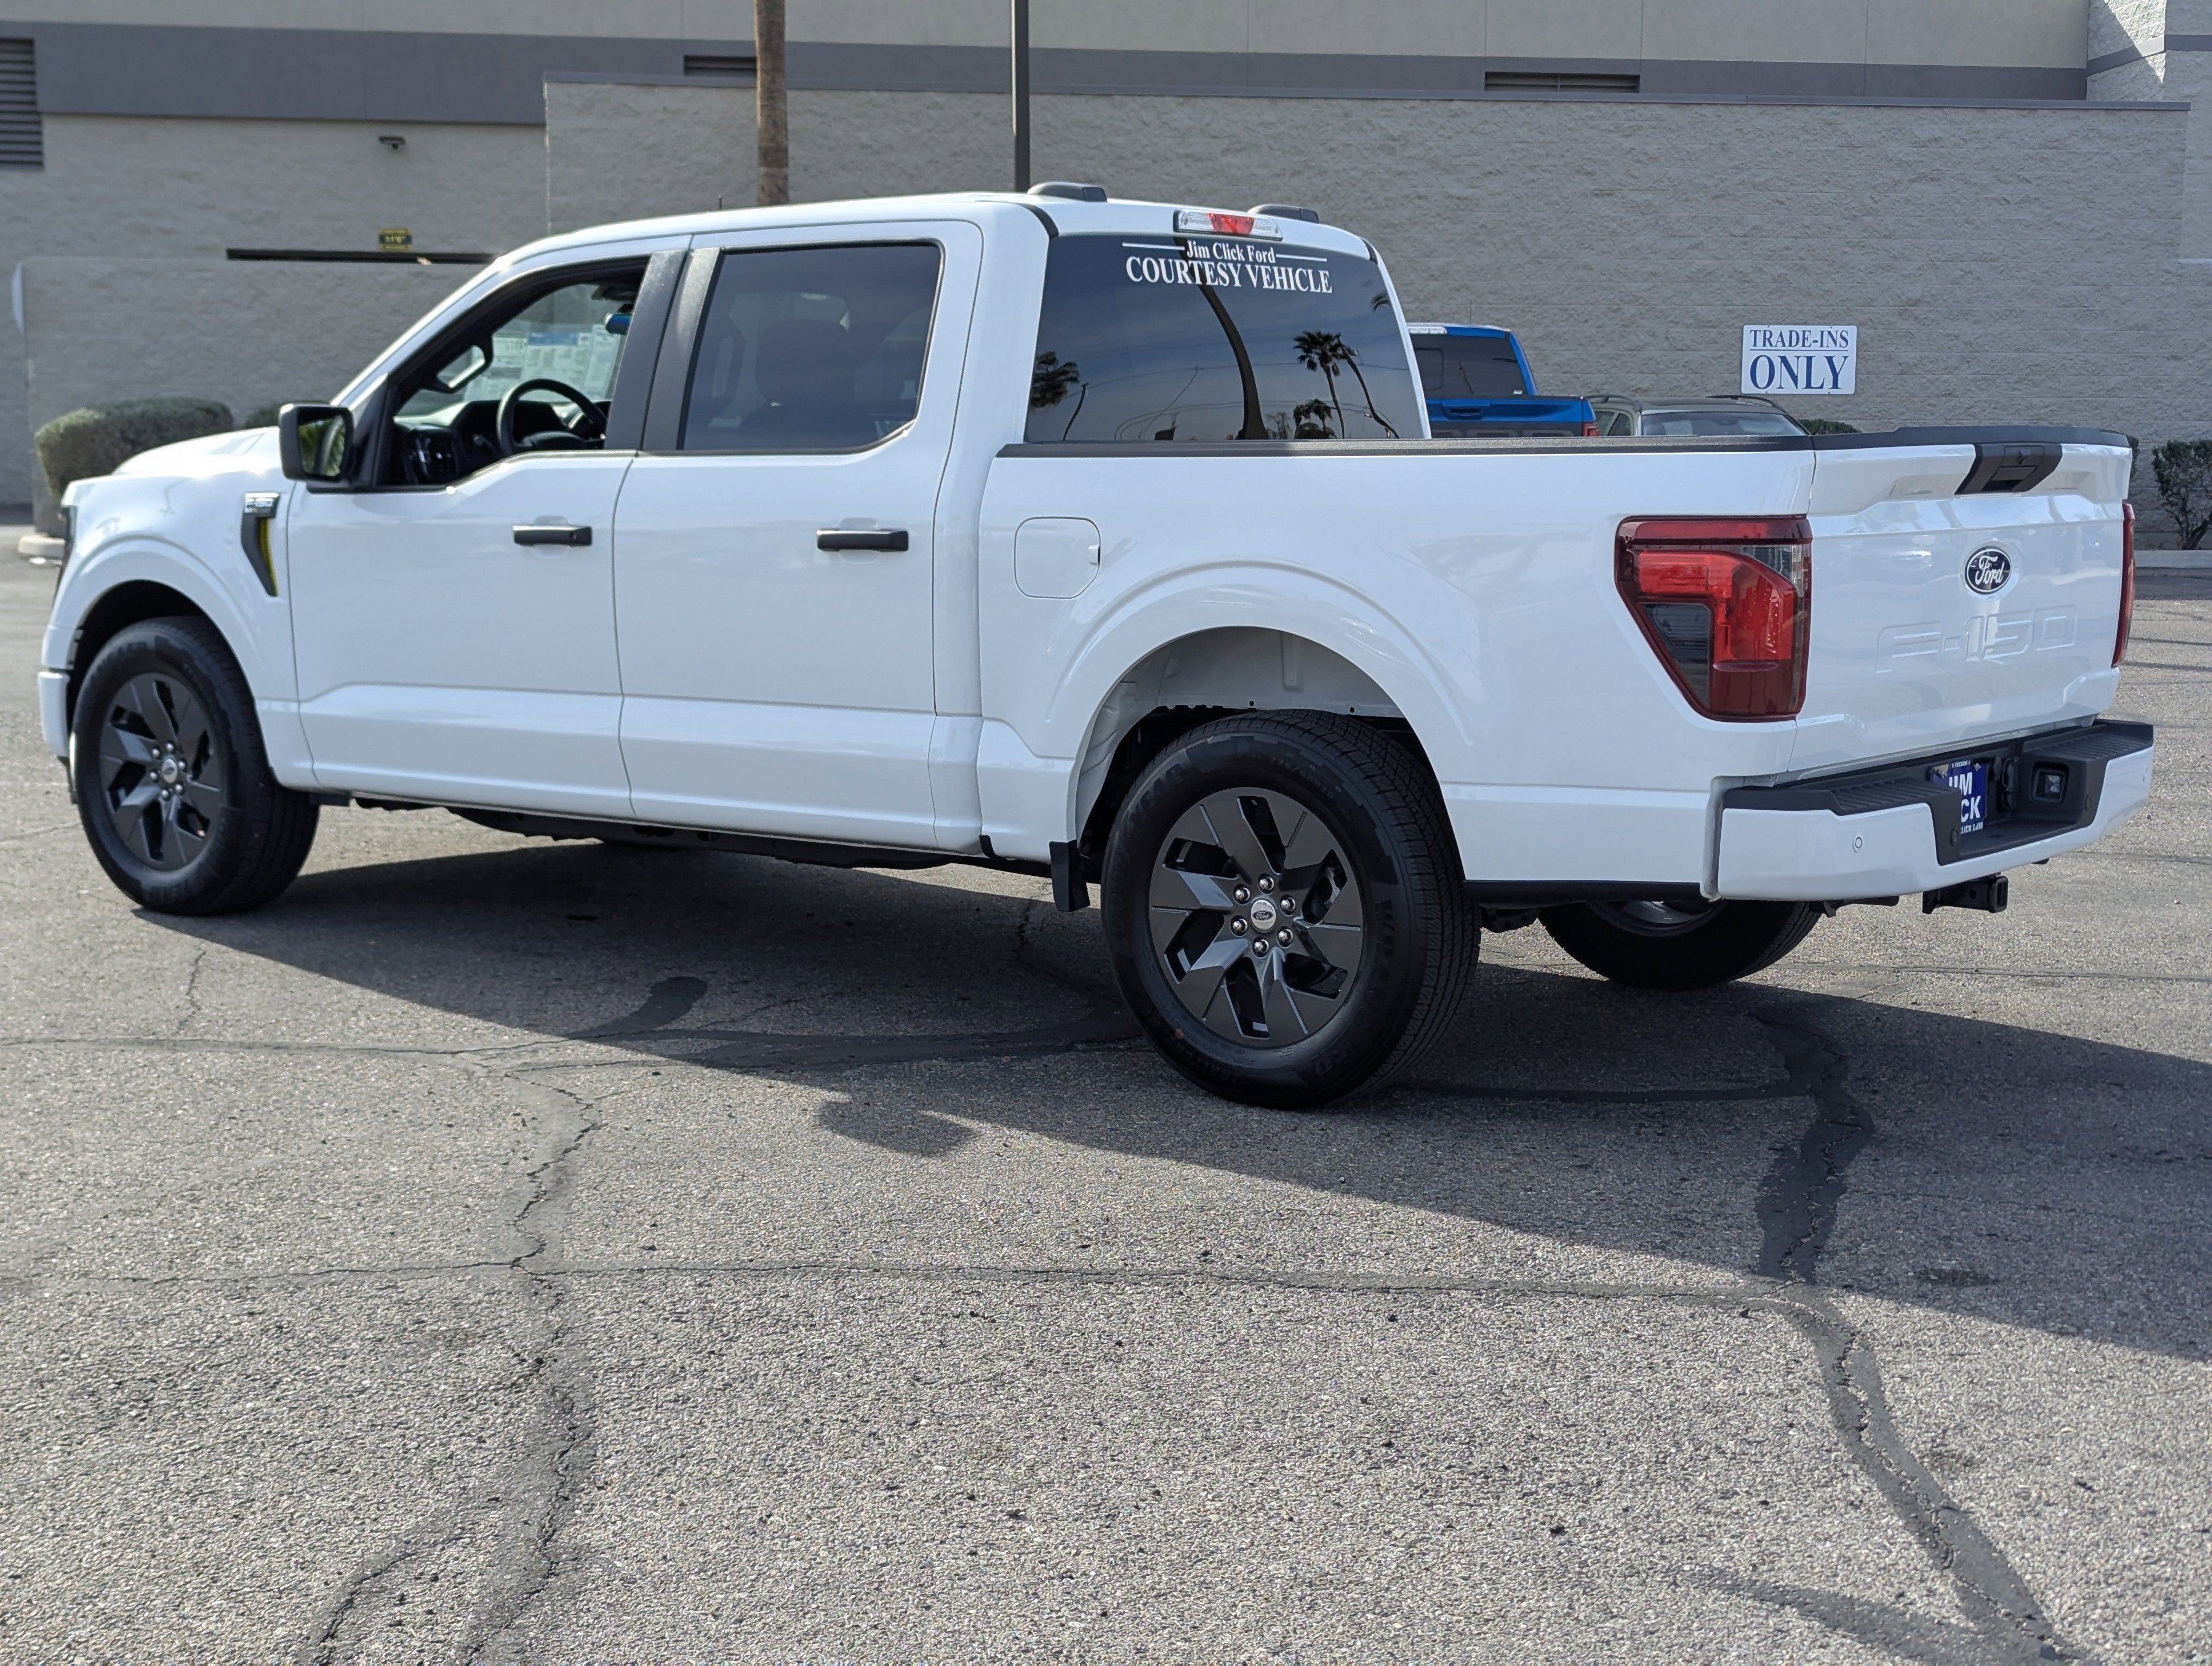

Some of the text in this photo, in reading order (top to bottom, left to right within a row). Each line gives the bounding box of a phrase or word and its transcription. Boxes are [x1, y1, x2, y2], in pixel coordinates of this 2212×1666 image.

[1186, 240, 1276, 264] Jim Click Ford
[1126, 255, 1333, 293] COURTESY VEHICLE
[1750, 330, 1849, 348] TRADE-INS
[1750, 355, 1849, 390] ONLY
[1975, 555, 2005, 585] Ford
